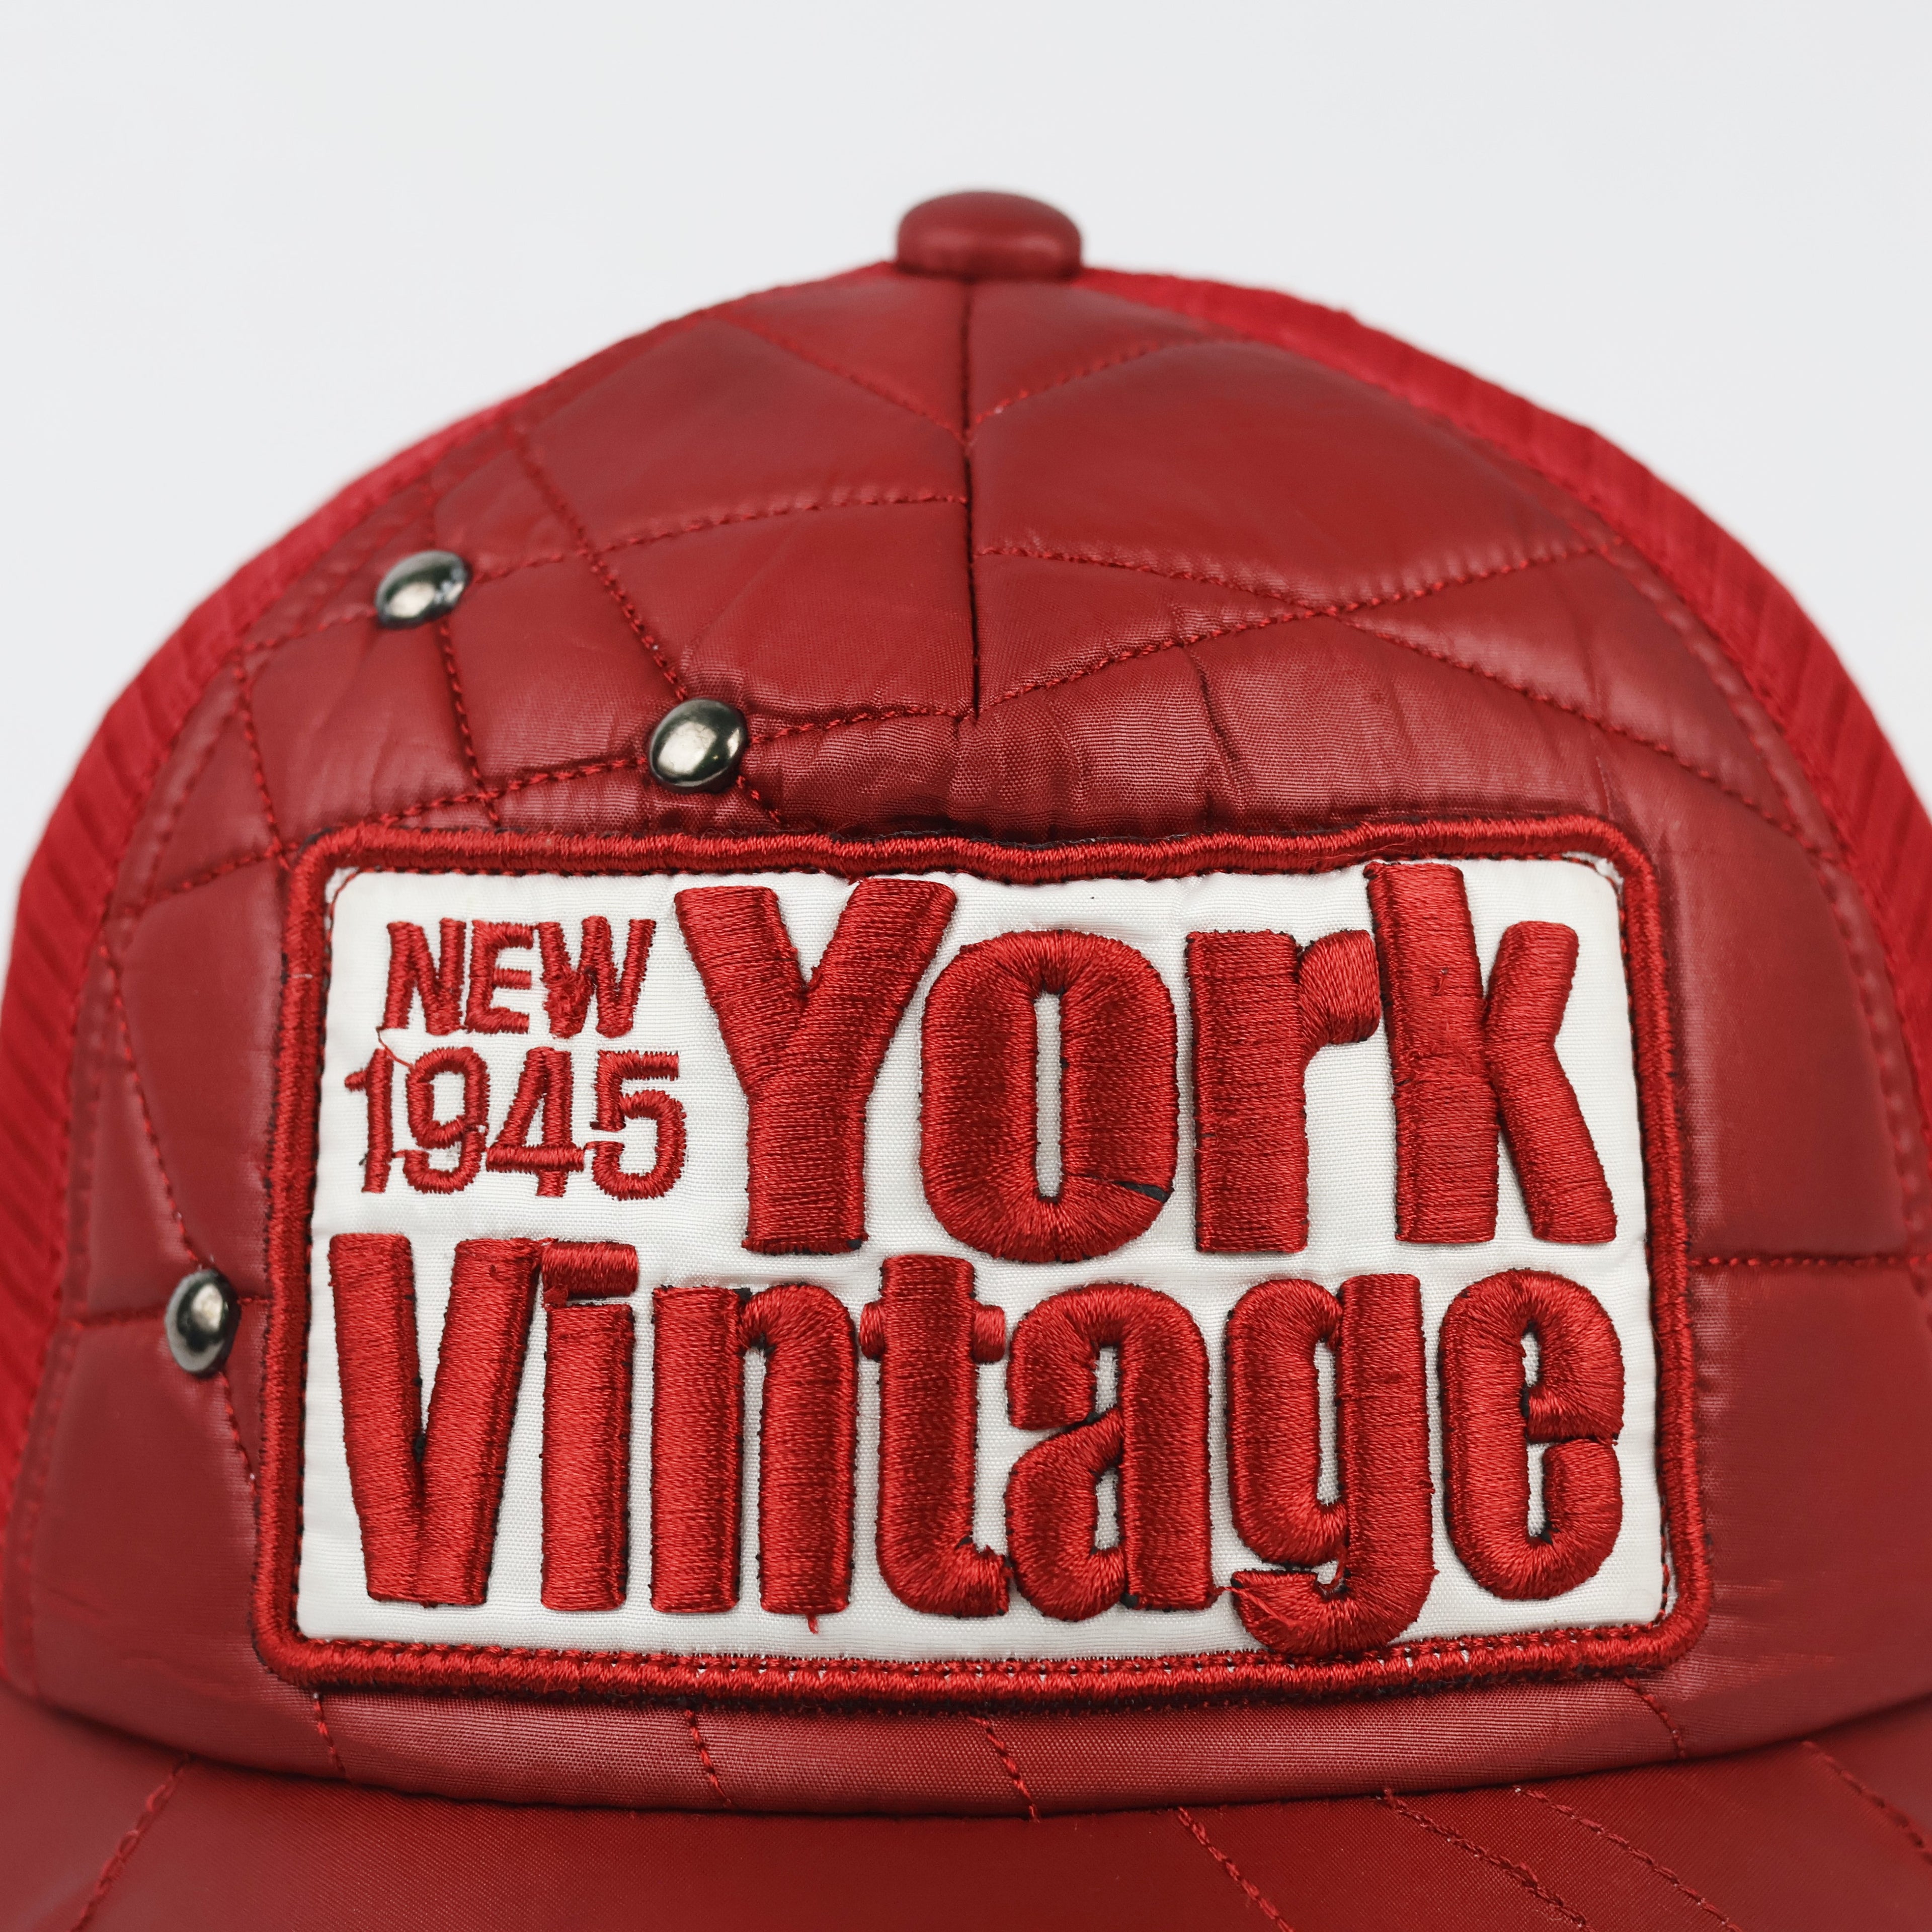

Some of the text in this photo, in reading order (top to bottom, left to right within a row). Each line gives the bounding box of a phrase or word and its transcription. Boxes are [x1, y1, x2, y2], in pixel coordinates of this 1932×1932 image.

[382, 916, 656, 1036] NEW
[674, 861, 1617, 1263] York
[346, 1047, 686, 1199] 1945
[328, 1232, 1625, 1650] Vintage
